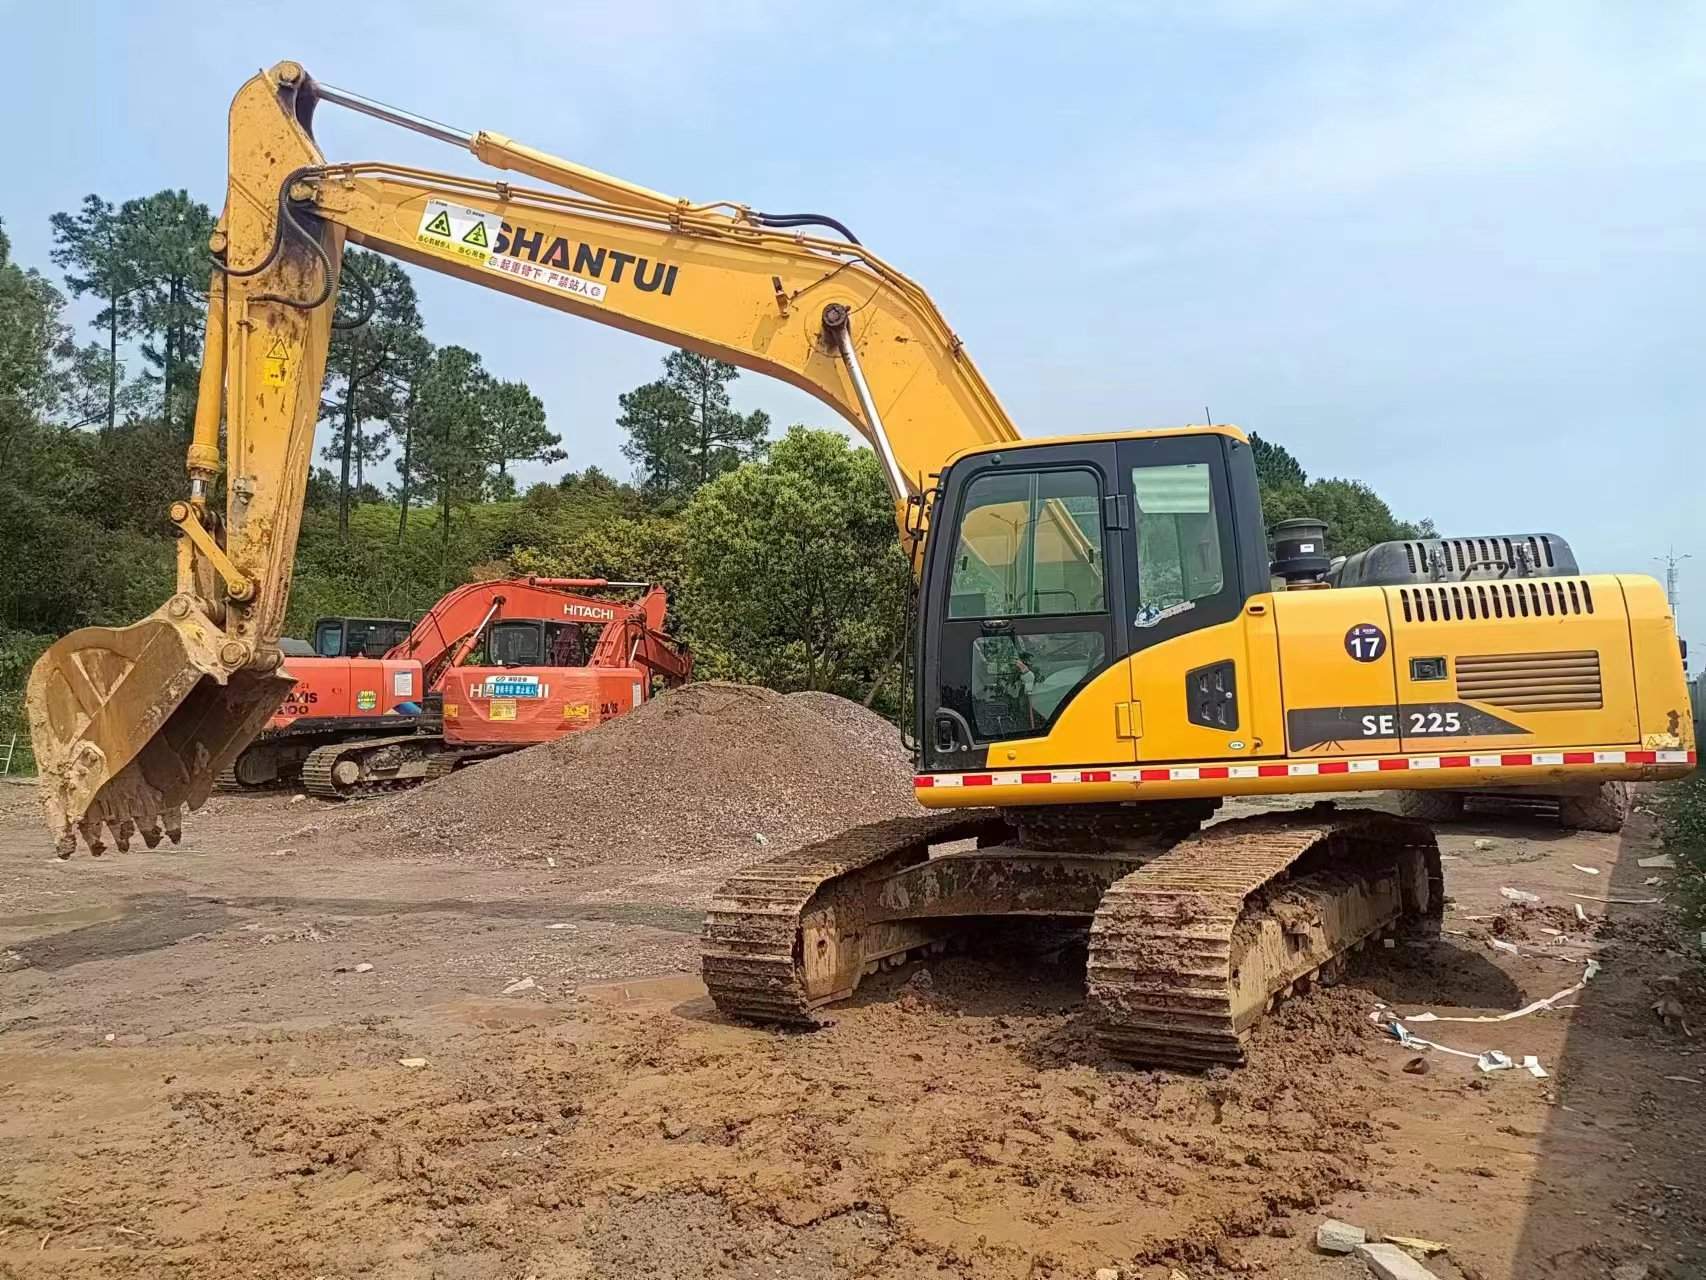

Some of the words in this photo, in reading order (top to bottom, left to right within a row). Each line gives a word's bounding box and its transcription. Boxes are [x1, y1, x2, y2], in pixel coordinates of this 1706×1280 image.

[494, 221, 678, 297] SHANTUI
[500, 258, 543, 280] 起重臂下
[547, 271, 589, 295] 严禁站人
[563, 603, 614, 620] HITACHI
[1350, 637, 1380, 658] 17
[286, 690, 318, 704] AXIS
[1361, 715, 1395, 736] SE
[1409, 712, 1461, 733] 225
